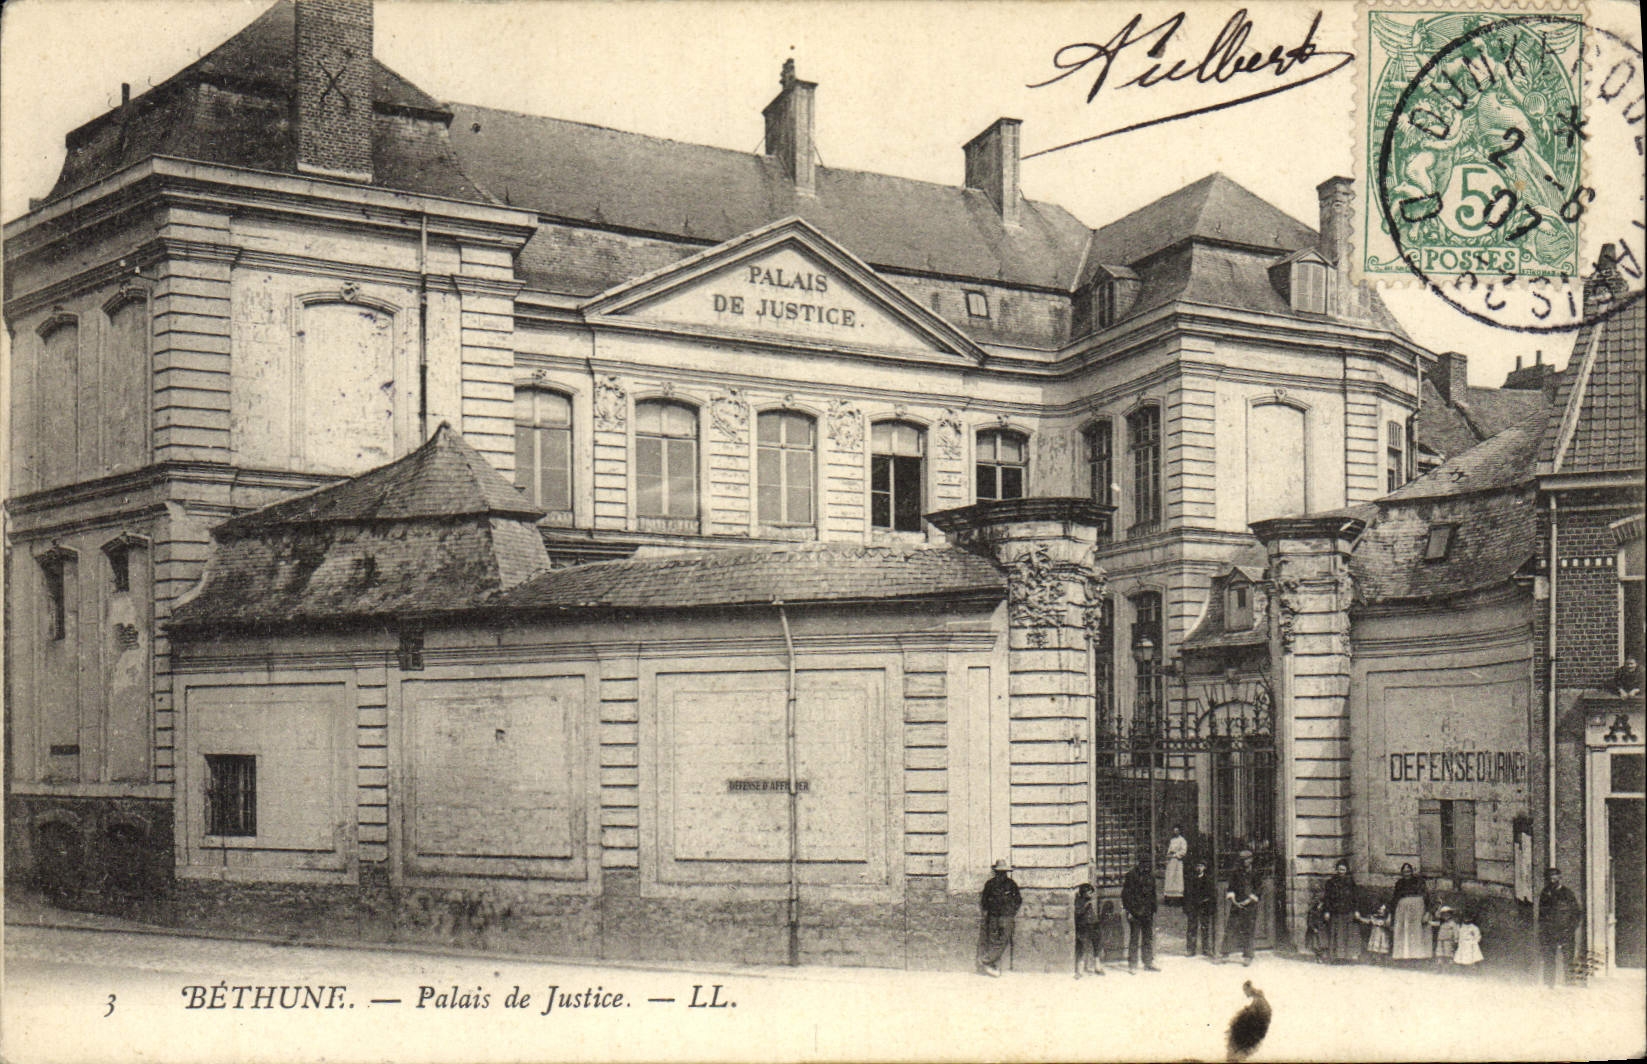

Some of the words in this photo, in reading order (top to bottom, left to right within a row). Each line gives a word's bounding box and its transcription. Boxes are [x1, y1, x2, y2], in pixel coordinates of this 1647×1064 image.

[1455, 167, 1495, 232] 5
[1423, 256, 1517, 272] POSTES
[749, 265, 828, 293] PALAIS
[713, 294, 744, 315] DE
